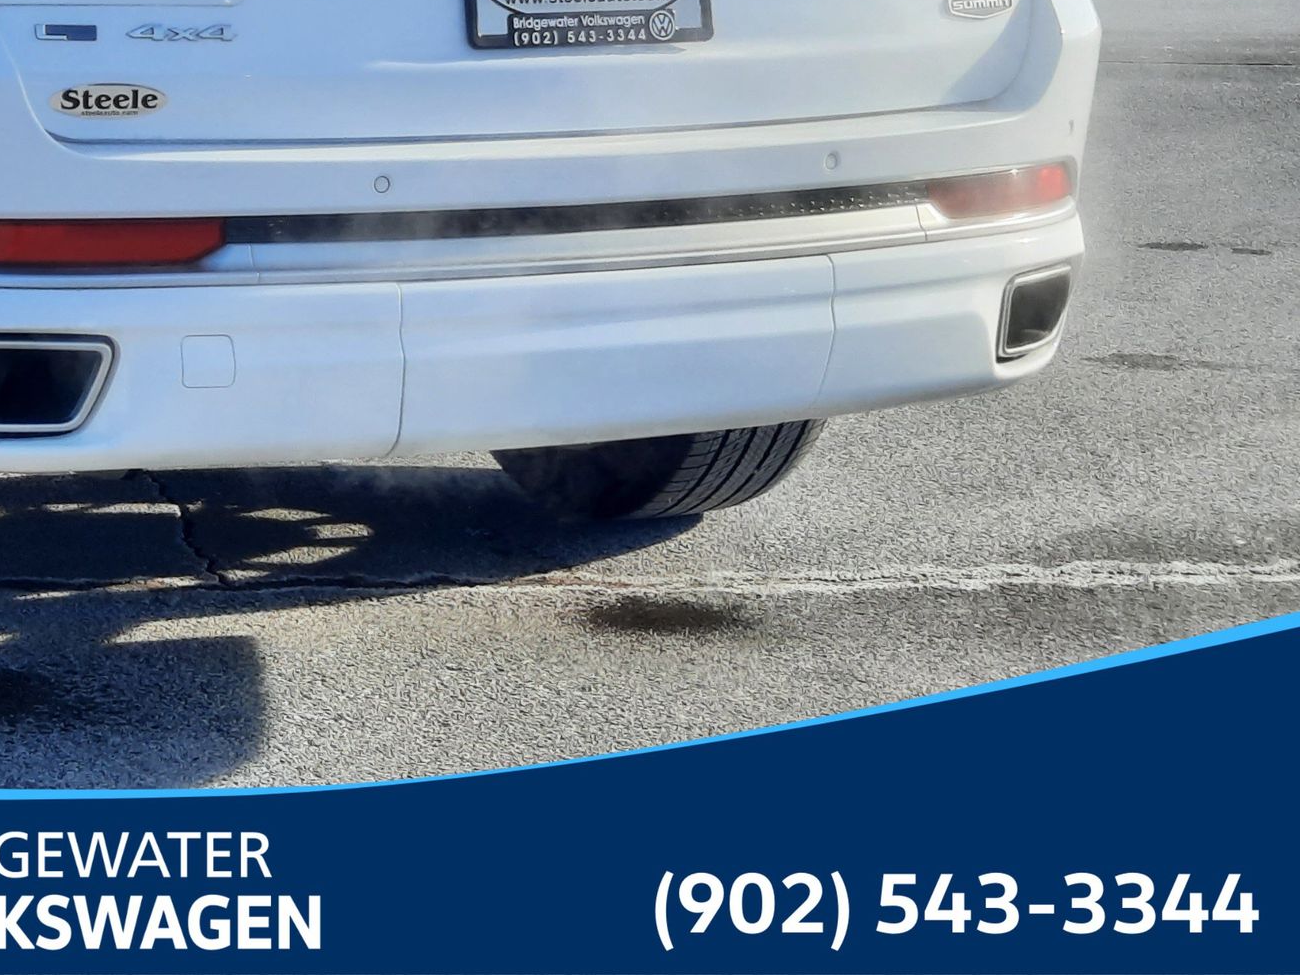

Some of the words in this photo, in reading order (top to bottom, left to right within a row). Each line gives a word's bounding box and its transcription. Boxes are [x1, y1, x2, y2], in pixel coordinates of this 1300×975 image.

[513, 16, 578, 30] Bridgewater
[581, 14, 646, 28] Volkswagen
[125, 23, 238, 42] 4x4
[514, 31, 558, 46] (902)
[567, 29, 647, 44] 543-3344
[60, 89, 159, 110] Steele
